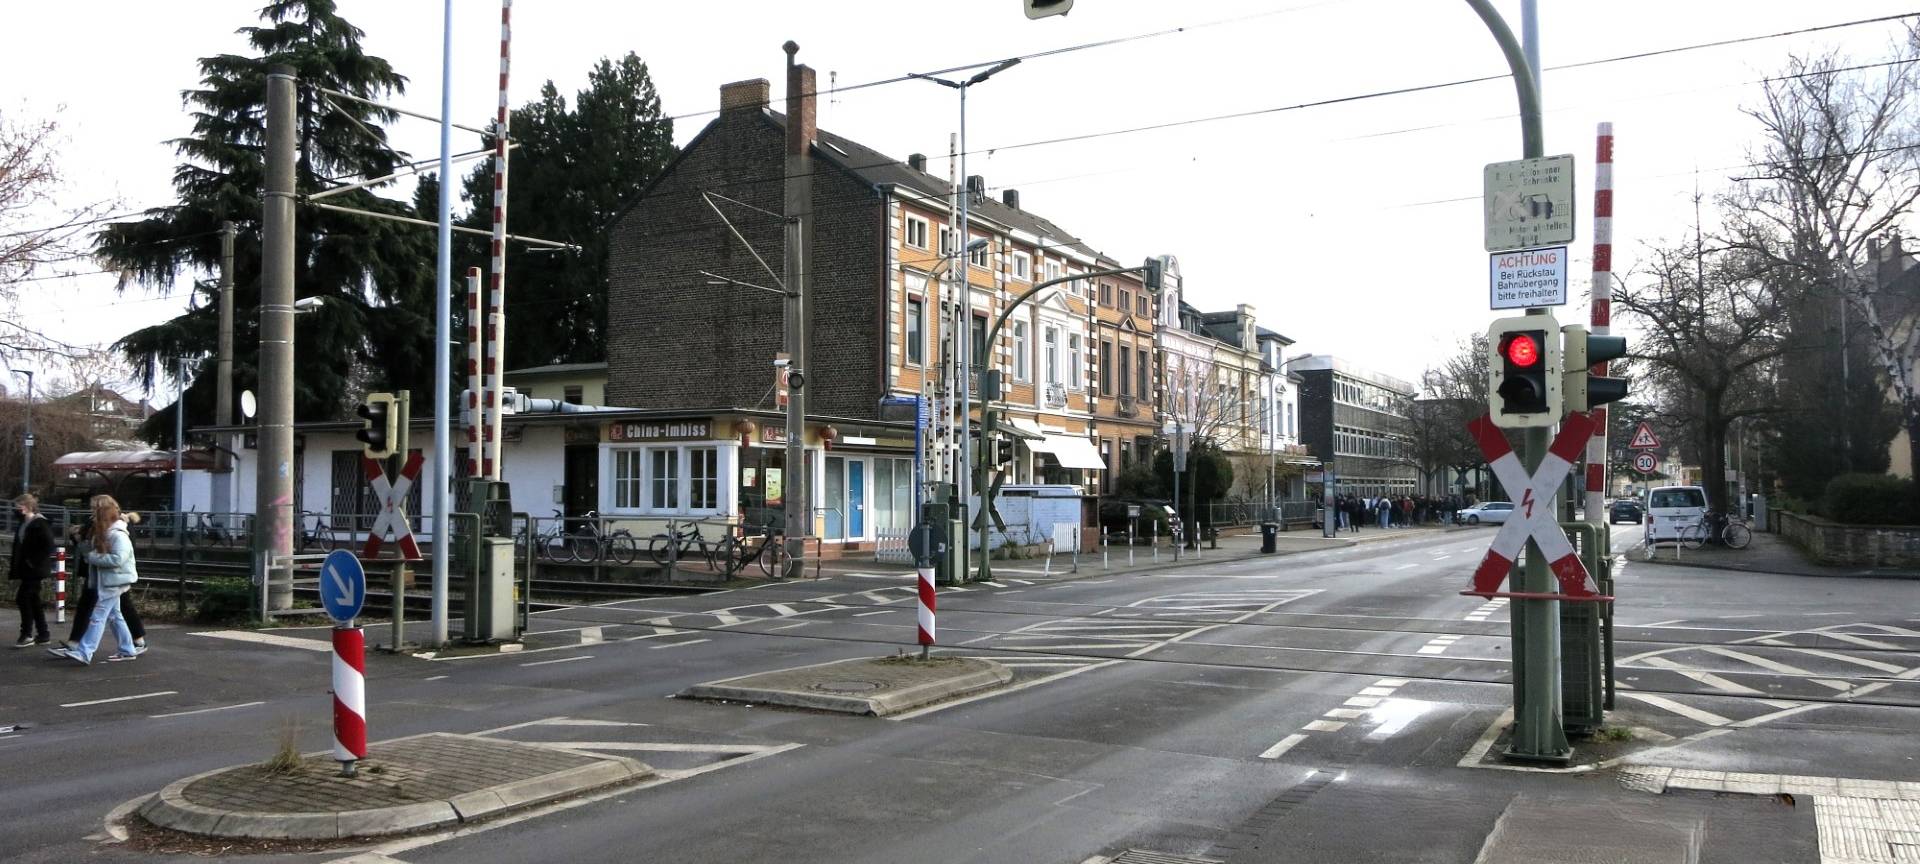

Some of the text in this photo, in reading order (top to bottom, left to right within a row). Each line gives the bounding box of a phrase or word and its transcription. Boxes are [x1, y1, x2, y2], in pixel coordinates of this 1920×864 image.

[1499, 253, 1557, 269] ACHTUNG
[1501, 268, 1556, 280] Bei Rückstau
[1498, 279, 1559, 290] Bahnübergang
[1498, 289, 1558, 301] bitte freihalten
[626, 423, 706, 438] China-Imbiss
[1640, 458, 1652, 467] 30
